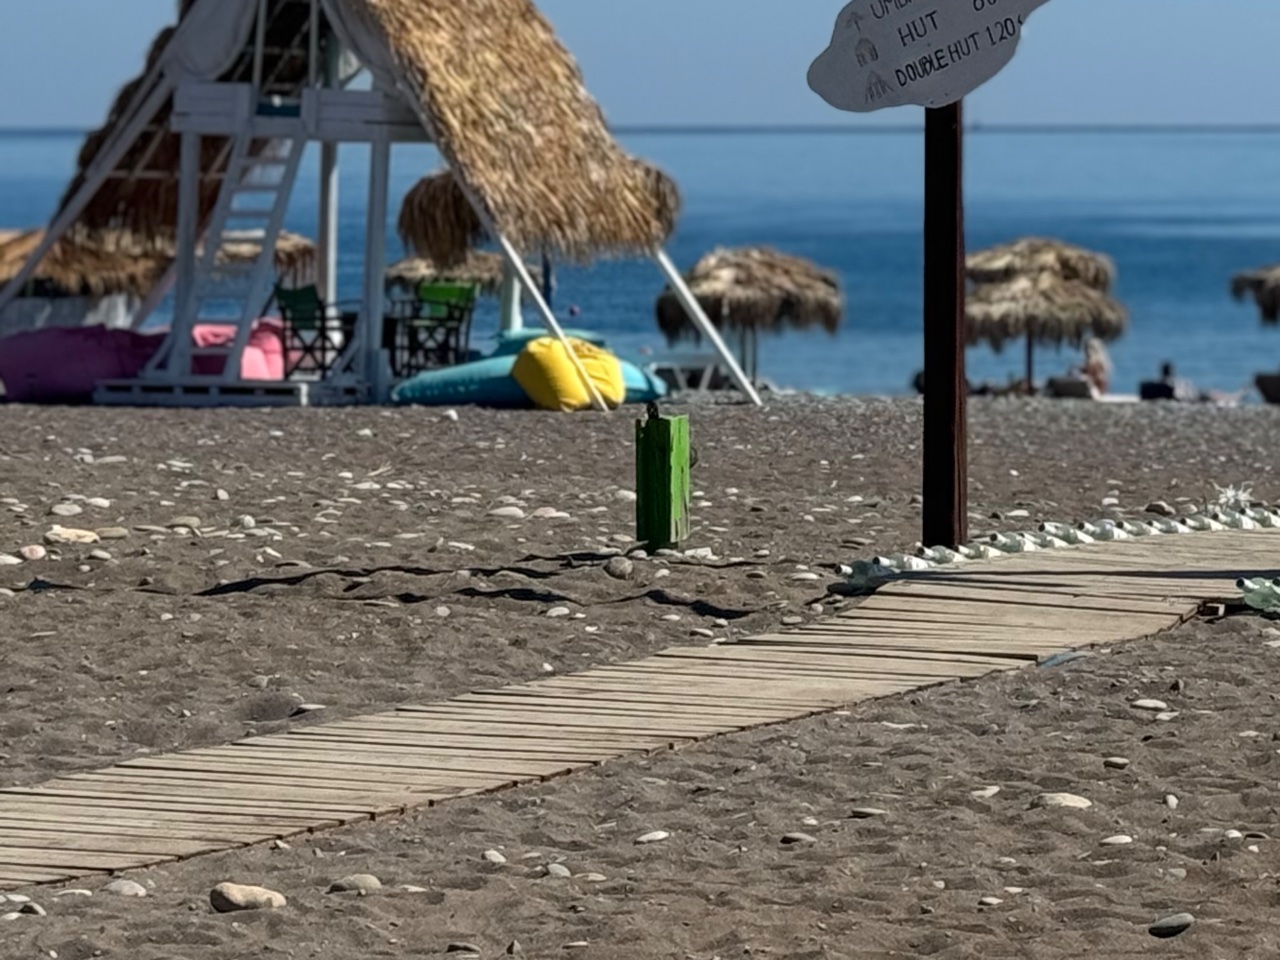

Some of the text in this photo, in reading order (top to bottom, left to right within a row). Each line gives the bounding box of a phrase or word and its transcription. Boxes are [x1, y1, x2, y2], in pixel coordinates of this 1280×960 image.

[898, 10, 940, 47] HUT
[895, 48, 949, 88] DOUBLE
[948, 31, 981, 64] HUT
